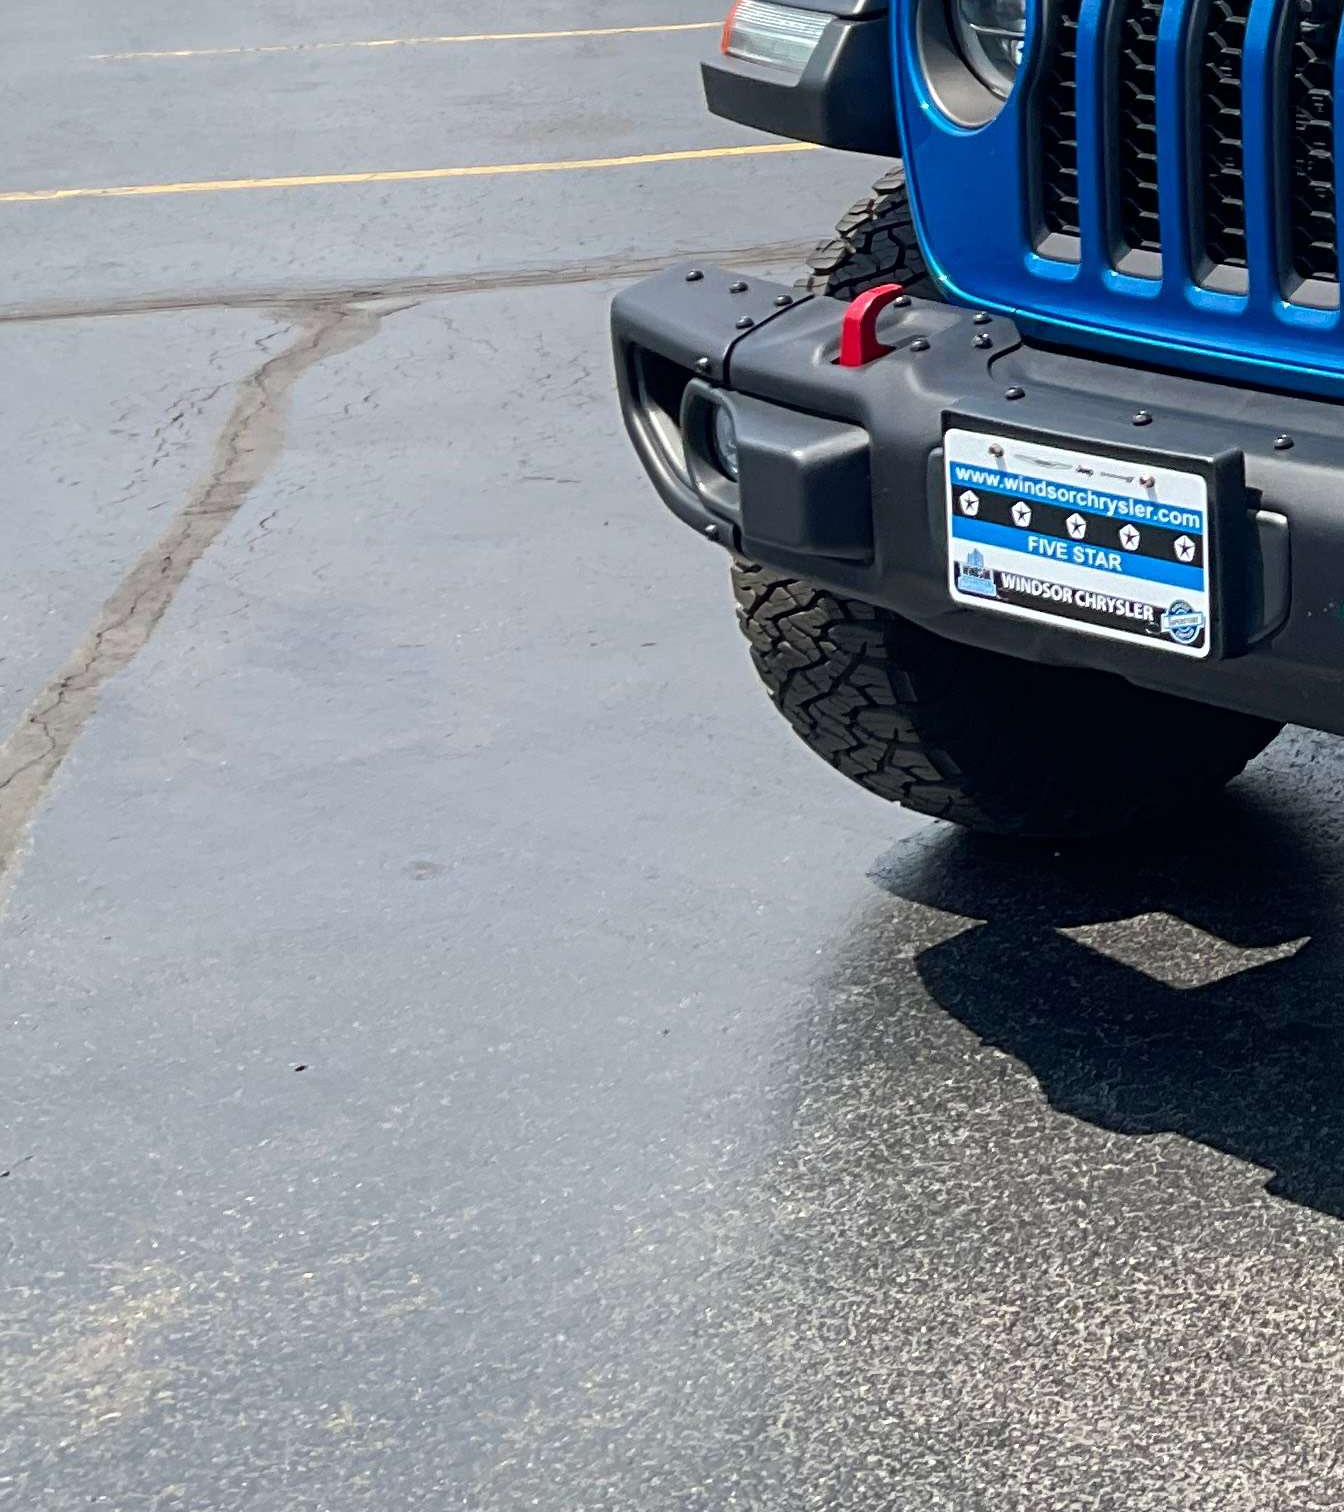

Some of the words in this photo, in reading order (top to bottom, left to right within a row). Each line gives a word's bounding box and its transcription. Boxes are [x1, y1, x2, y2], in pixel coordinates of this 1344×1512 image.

[956, 466, 1200, 528] www.windsorchrysler.com
[1028, 535, 1068, 560] FIVE
[1073, 547, 1122, 572] STAR
[1001, 572, 1073, 604] WINDSOR
[1075, 589, 1154, 622] CHRYSLER
